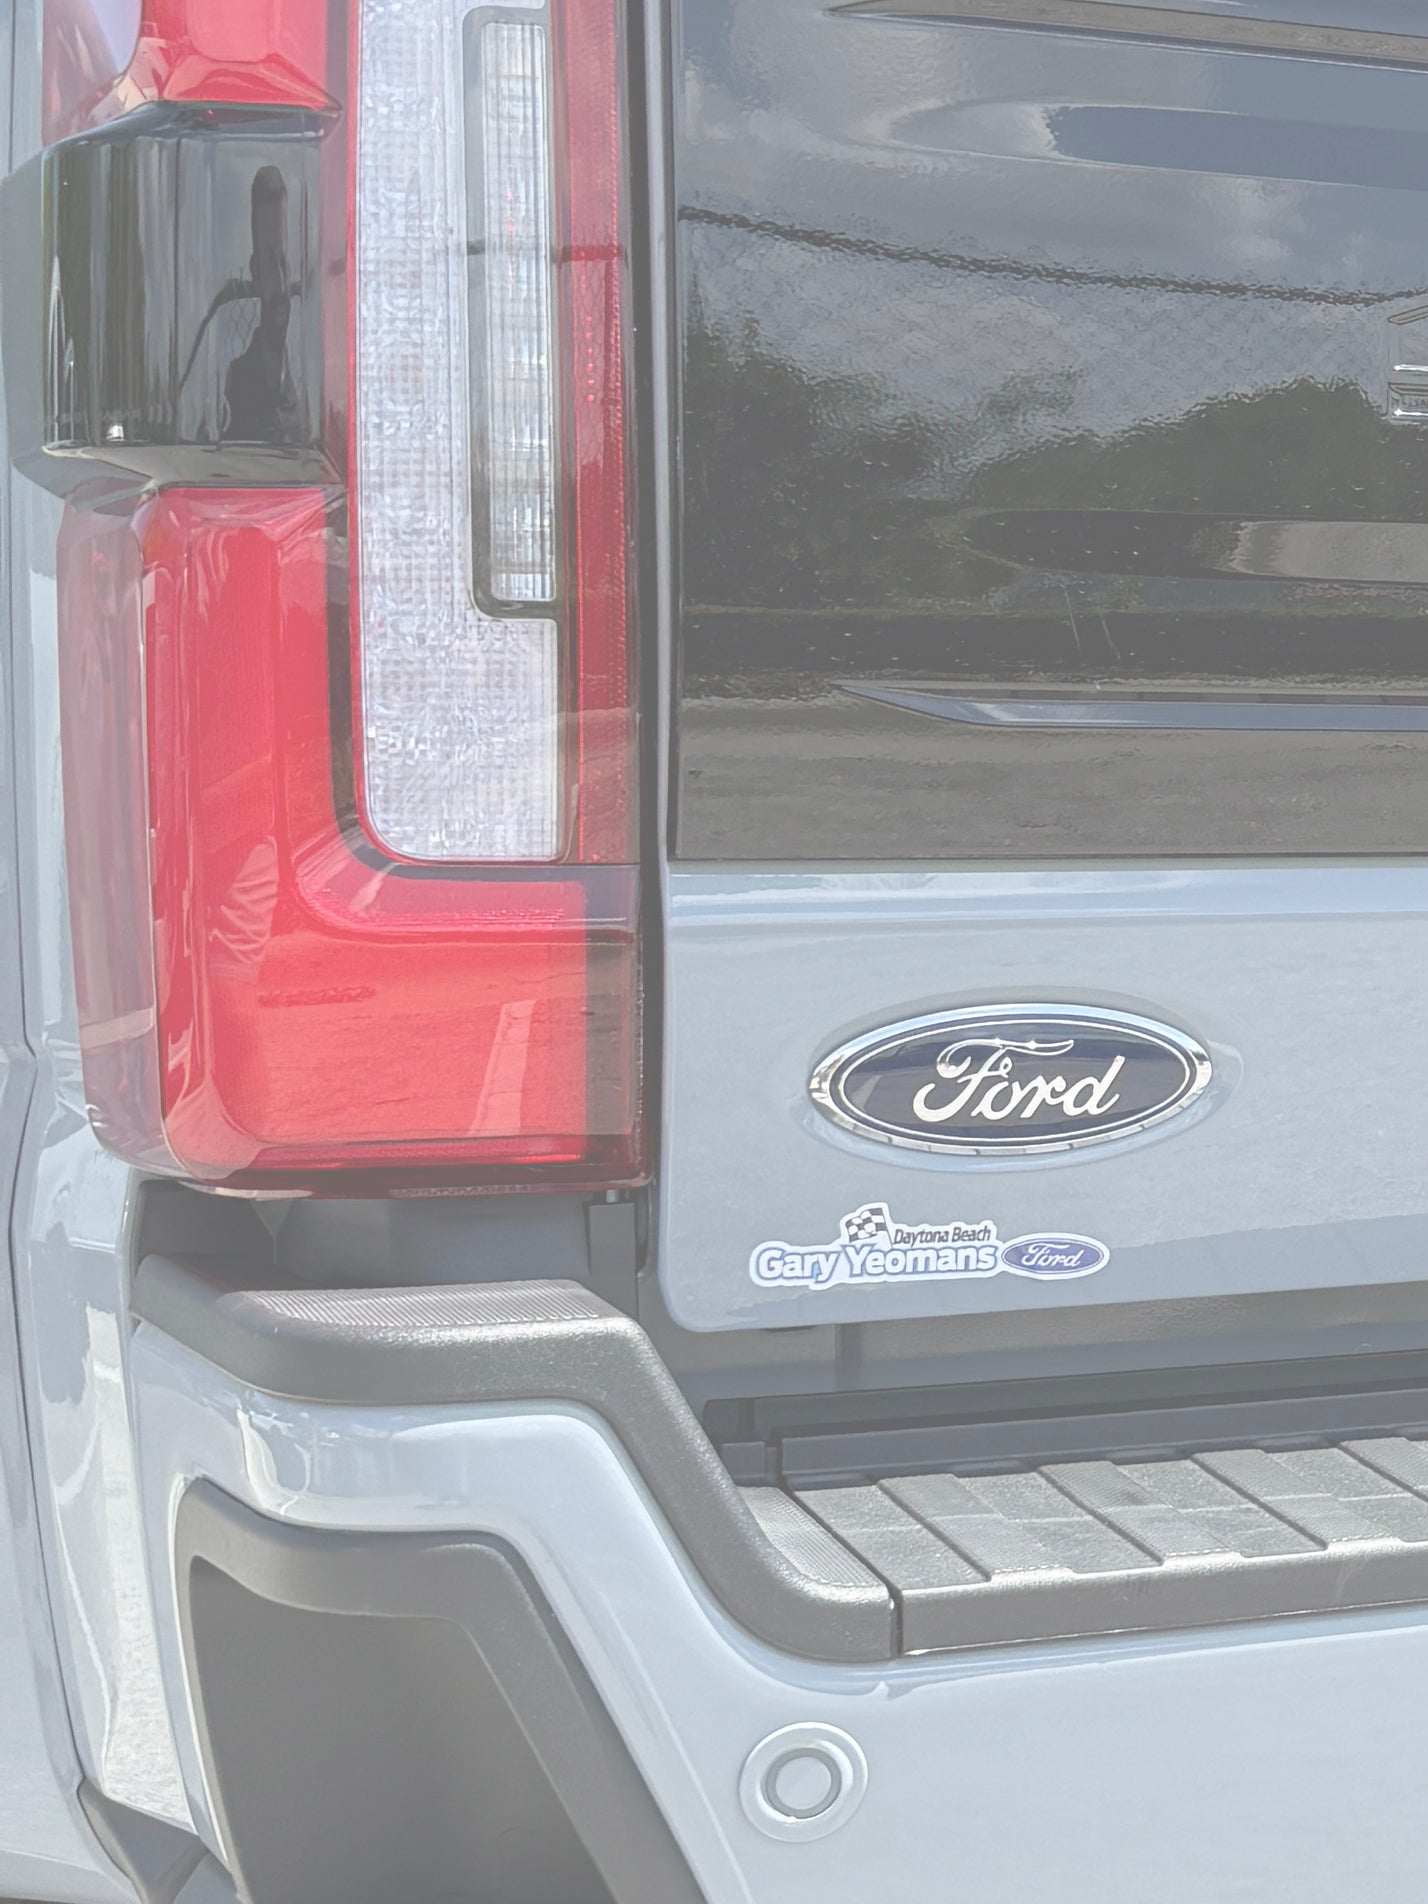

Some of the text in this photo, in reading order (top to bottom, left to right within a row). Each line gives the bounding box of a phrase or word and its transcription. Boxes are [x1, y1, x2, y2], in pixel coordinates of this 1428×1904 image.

[912, 1038, 1126, 1123] Ford
[893, 1225, 991, 1245] Daytona Beach
[755, 1243, 997, 1284] Gary Yeomans
[1021, 1243, 1082, 1268] Ford
